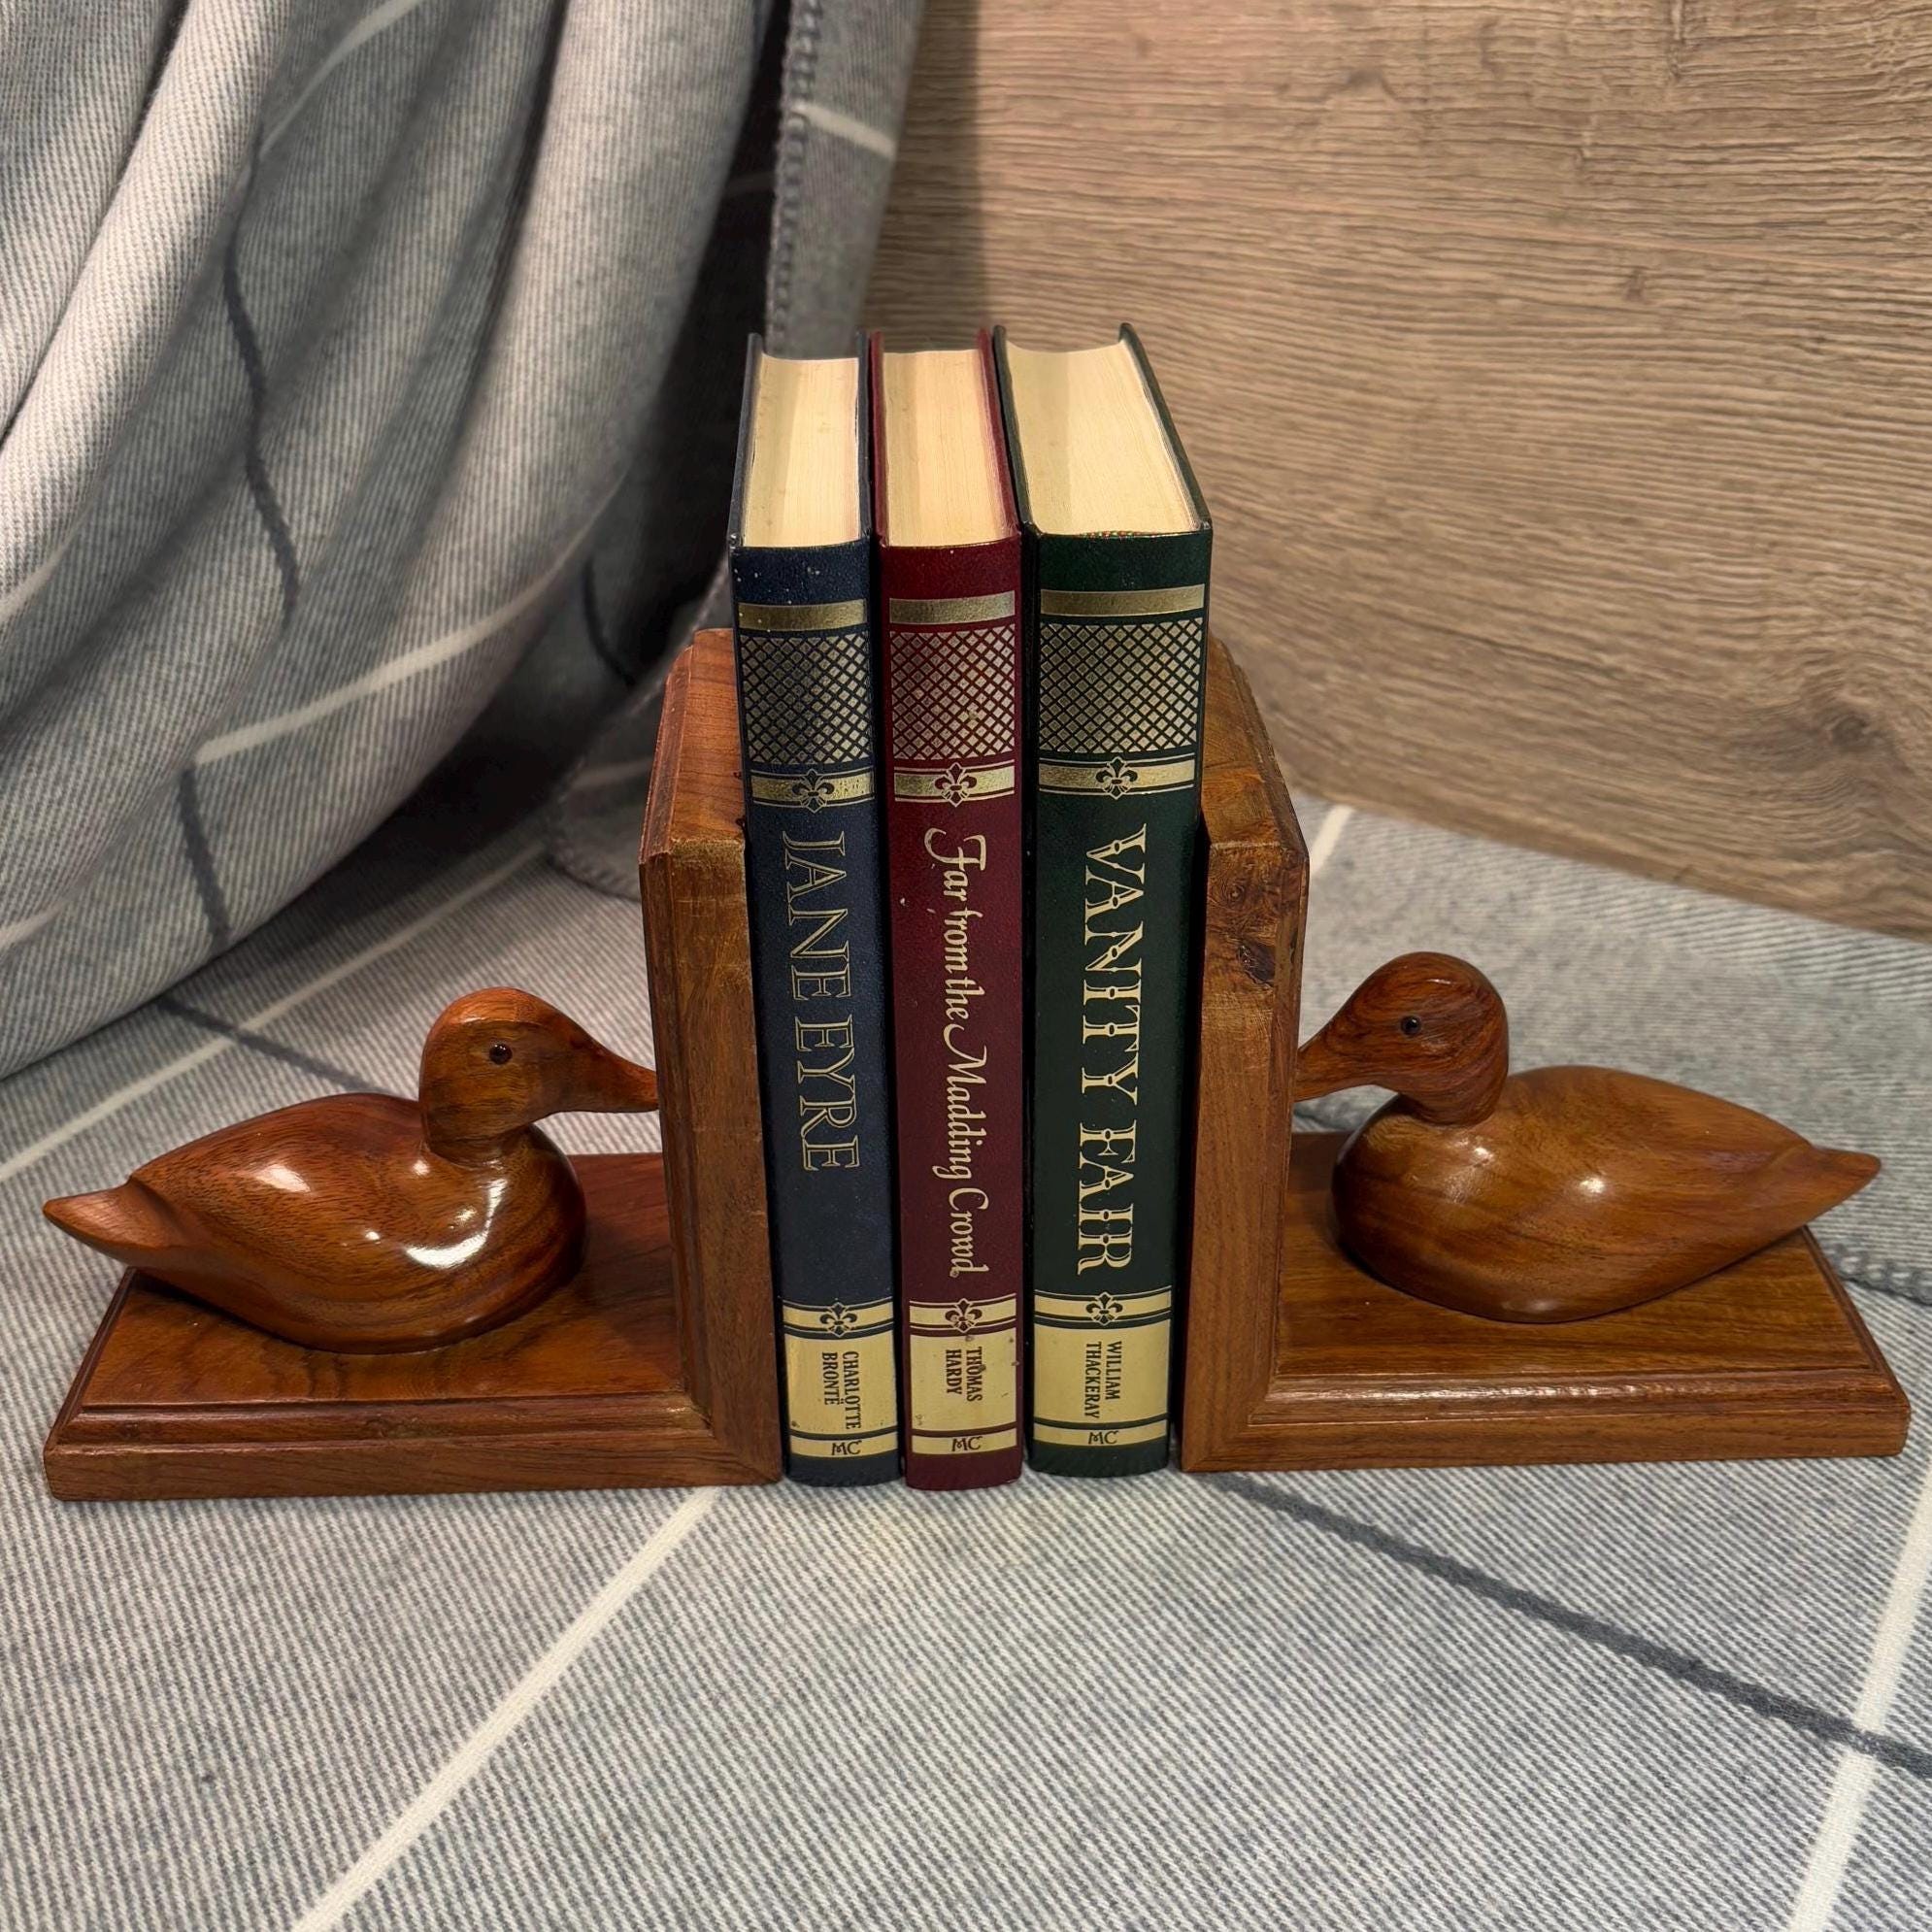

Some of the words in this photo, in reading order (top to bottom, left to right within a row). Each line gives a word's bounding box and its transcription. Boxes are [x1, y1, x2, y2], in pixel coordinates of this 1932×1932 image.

[923, 826, 987, 902] Far
[783, 830, 852, 1002] JANE
[927, 905, 983, 973] from
[945, 975, 986, 1020] the
[1081, 822, 1148, 1106] VANITY
[794, 1014, 861, 1172] EYRE
[931, 1021, 988, 1181] Madding
[948, 1186, 990, 1279] Crowd
[1077, 1119, 1138, 1277] FAIR
[821, 1350, 843, 1407] BRONTË
[841, 1349, 862, 1431] CHARLOTTE
[945, 1348, 963, 1396] HARDY
[965, 1346, 983, 1403] THOMAS
[1083, 1341, 1102, 1420] THACKERAY
[1103, 1340, 1123, 1401] WILLIAM
[831, 1440, 863, 1456] MC
[950, 1435, 982, 1452] MC
[1087, 1430, 1119, 1446] MC
